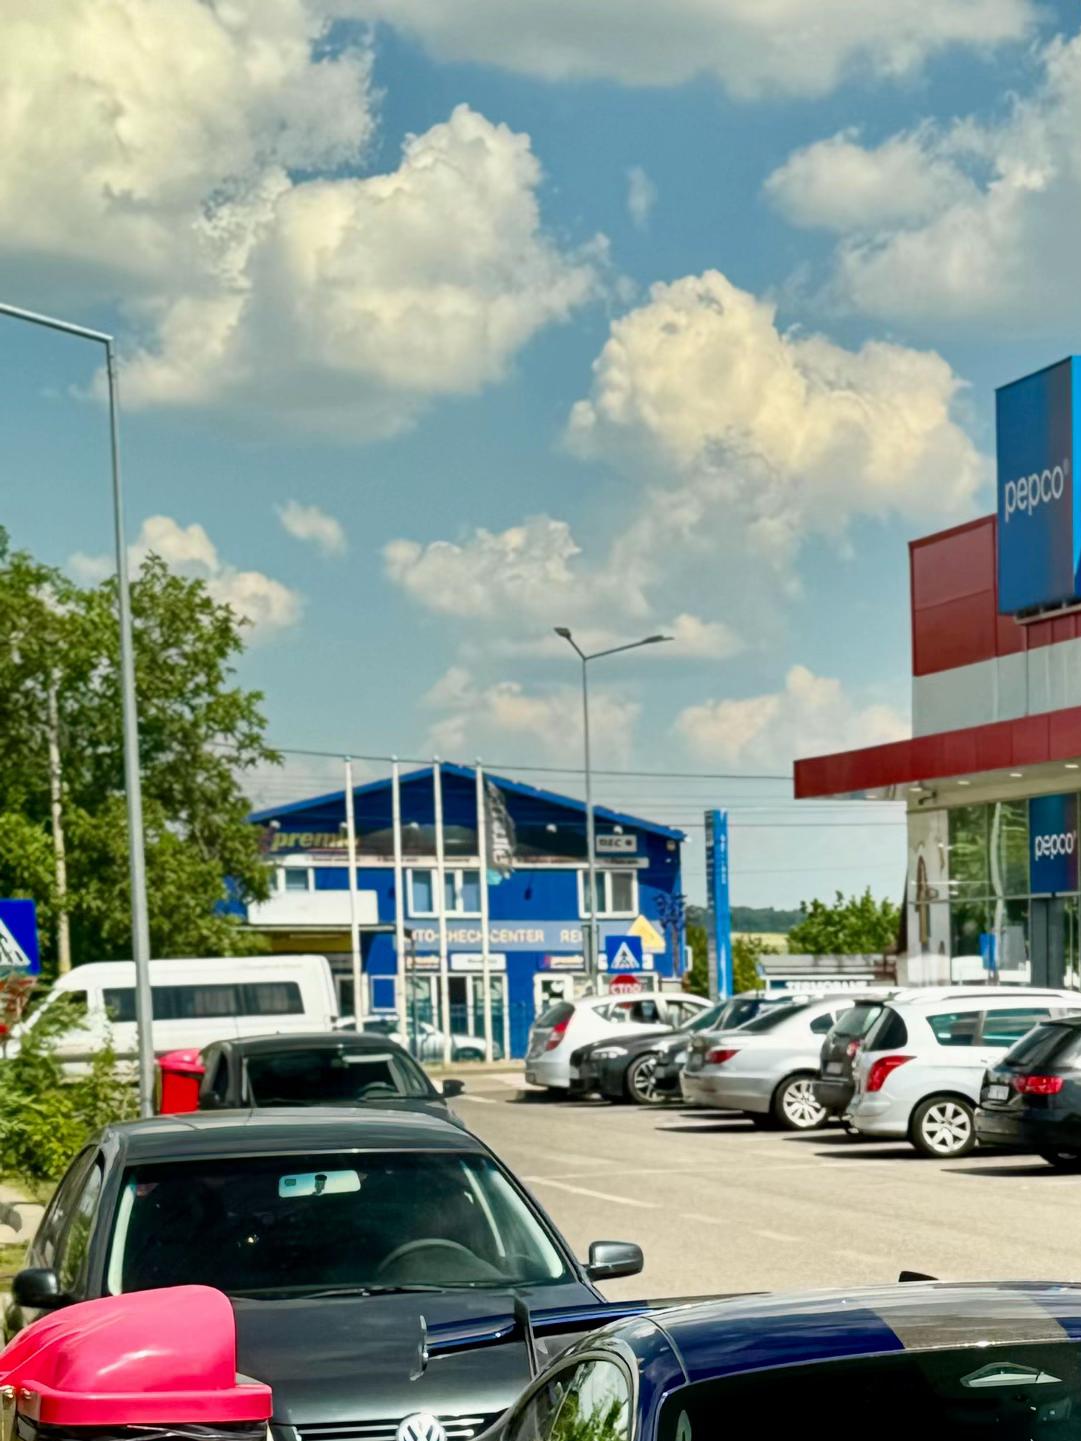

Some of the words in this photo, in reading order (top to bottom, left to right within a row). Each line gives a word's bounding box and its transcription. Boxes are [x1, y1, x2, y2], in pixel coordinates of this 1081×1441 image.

[1005, 466, 1064, 523] pepco
[1034, 832, 1074, 862] pepco
[490, 928, 544, 943] CENTER
